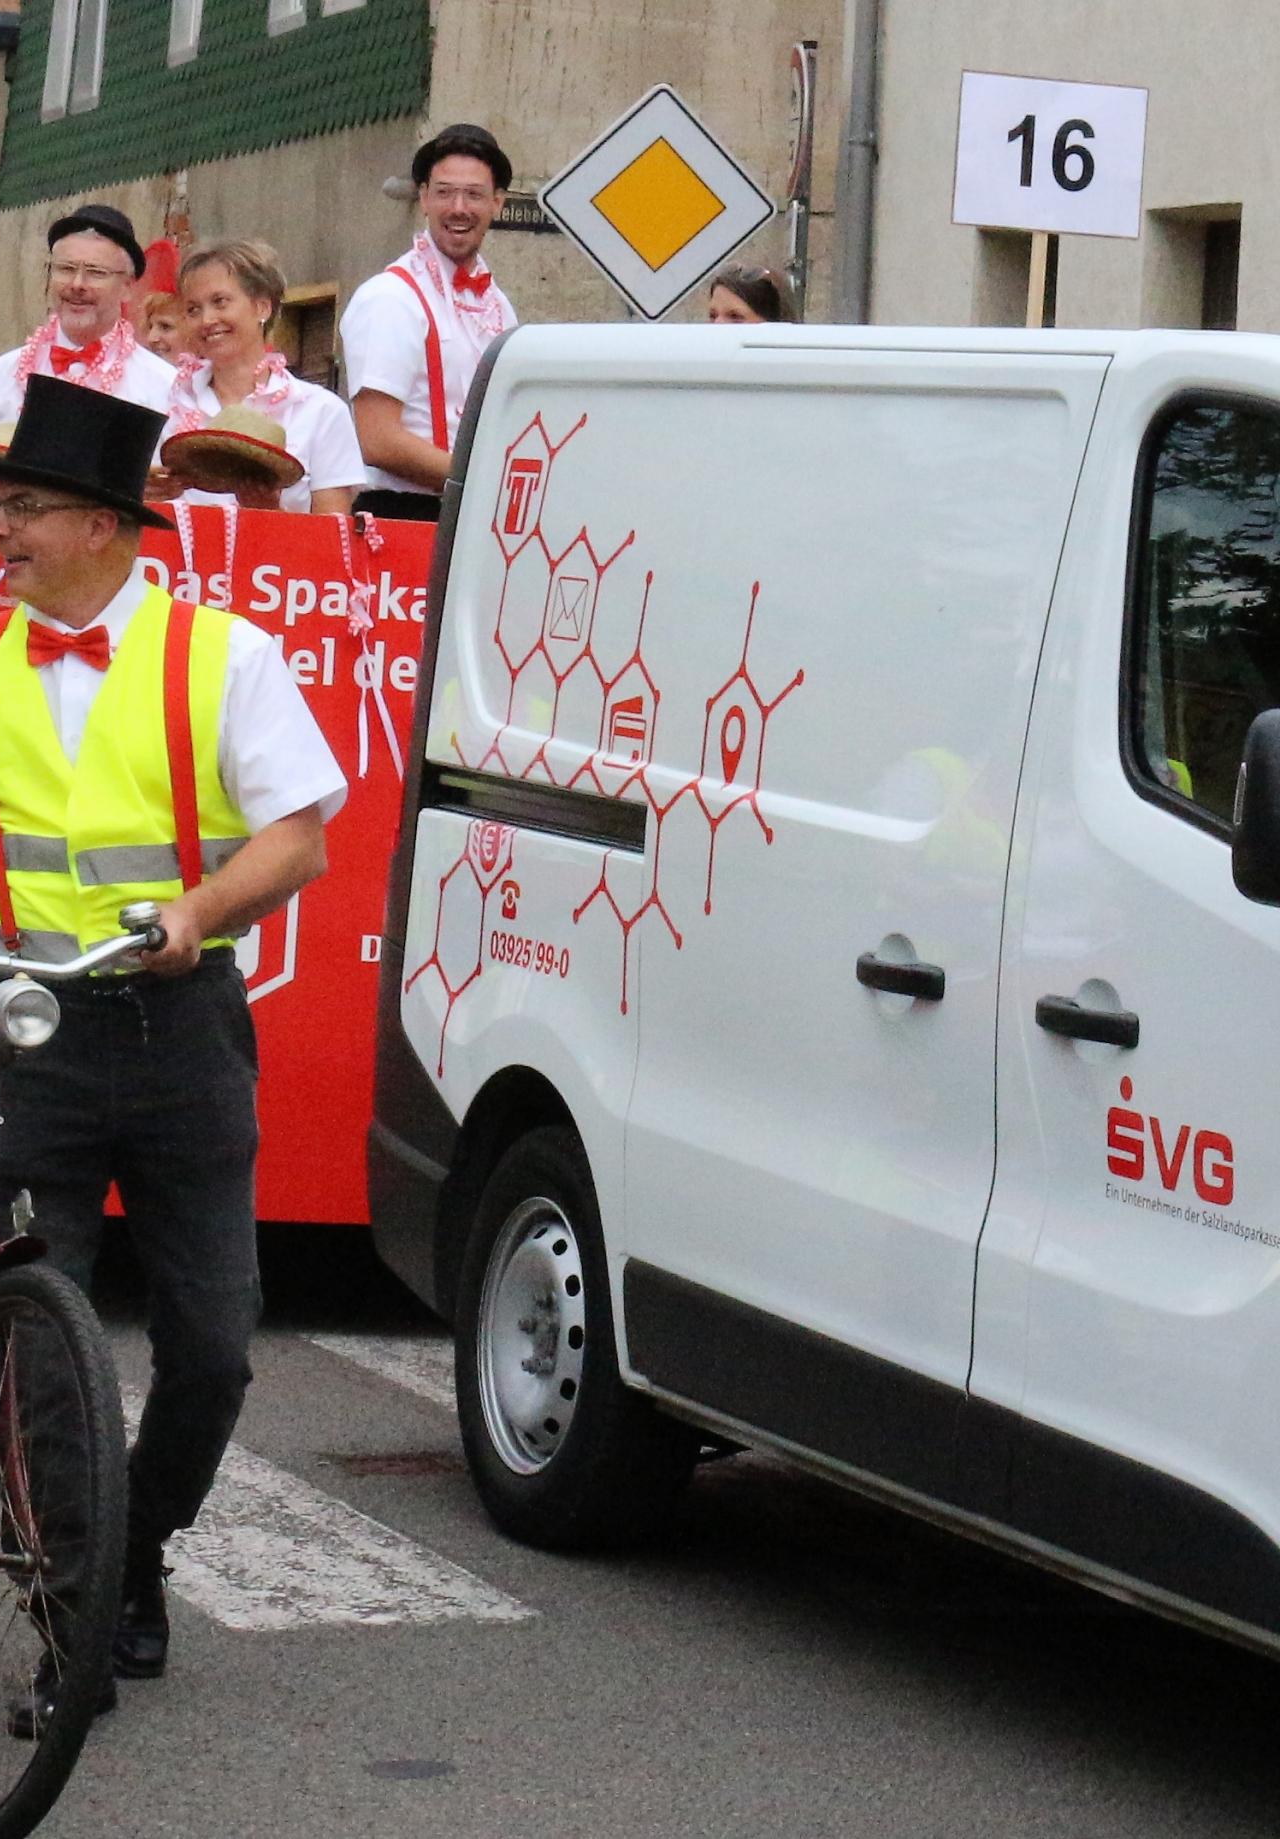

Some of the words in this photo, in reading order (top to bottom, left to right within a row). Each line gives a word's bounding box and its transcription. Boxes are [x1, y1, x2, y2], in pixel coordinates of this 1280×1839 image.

[1007, 114, 1096, 192] 16
[134, 556, 234, 609] Das
[490, 930, 570, 979] 03925/99-0
[1107, 1076, 1234, 1207] SVG
[1105, 1182, 1120, 1201] Ein
[1120, 1186, 1183, 1219] Unternehmen
[1184, 1206, 1200, 1224] der
